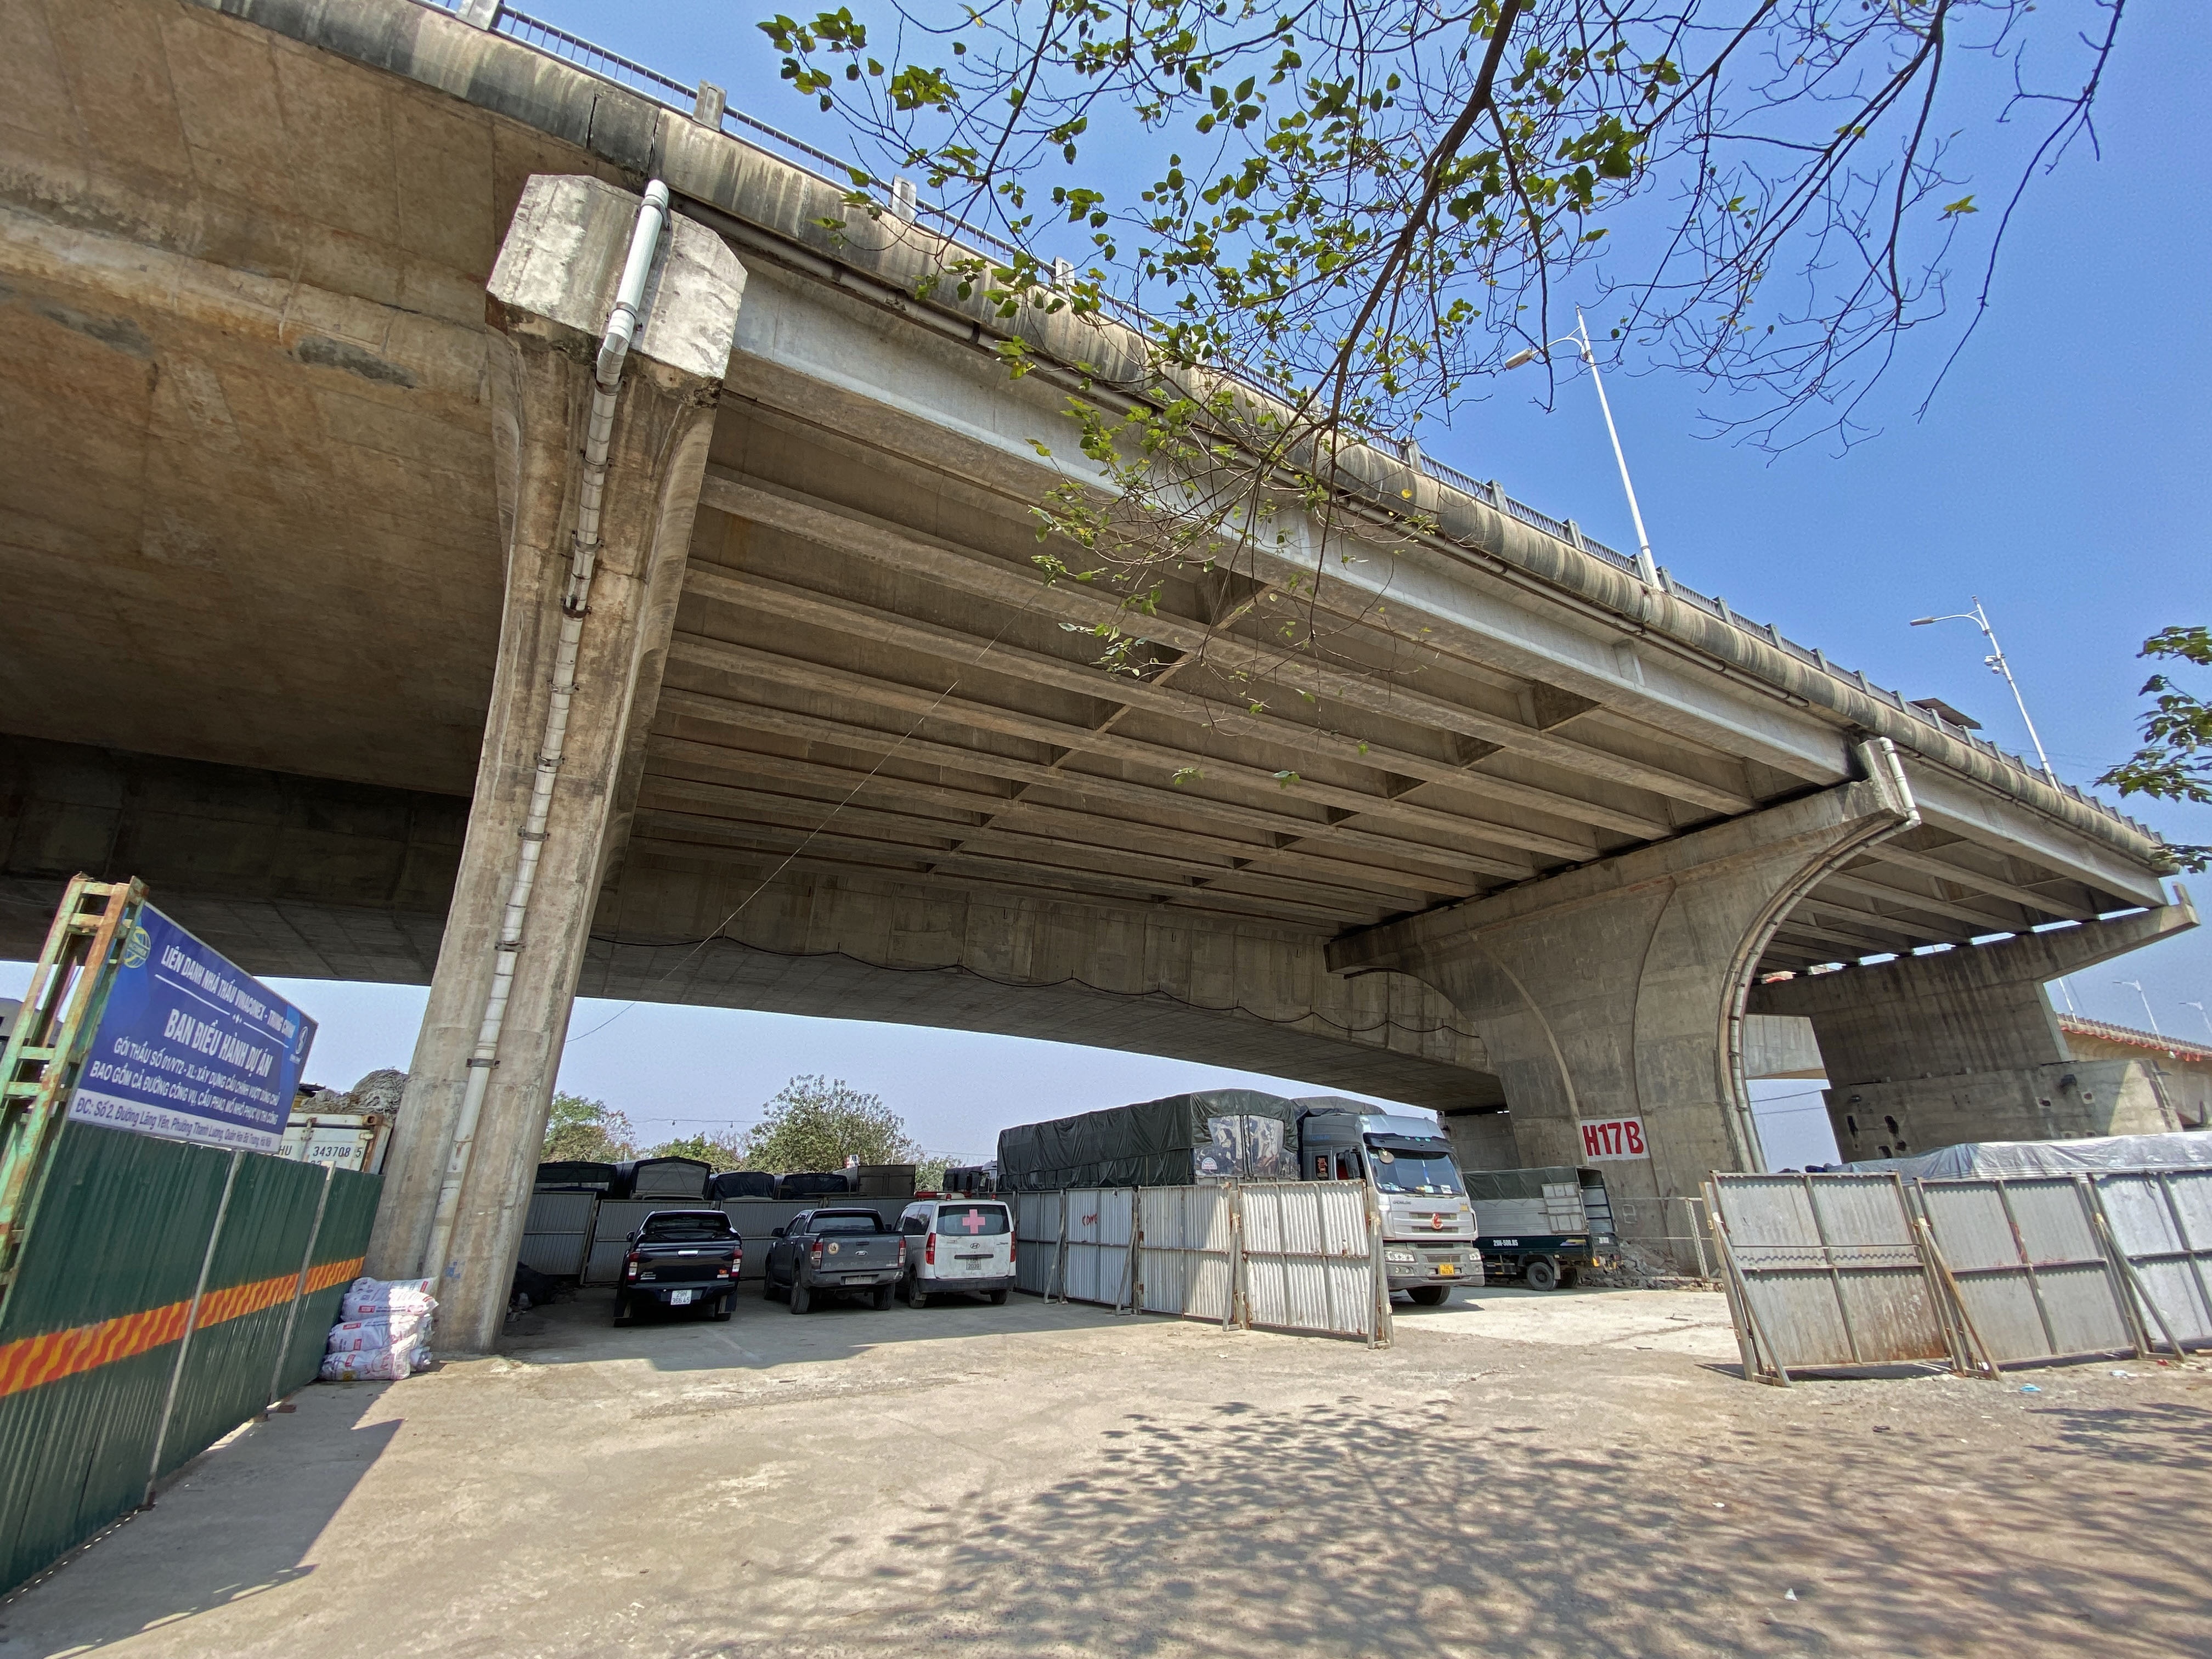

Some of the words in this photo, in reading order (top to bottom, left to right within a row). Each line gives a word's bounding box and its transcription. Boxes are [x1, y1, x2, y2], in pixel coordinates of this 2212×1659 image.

[161, 945, 185, 973] LIÊN
[180, 957, 205, 985] DANH
[201, 969, 221, 994] NHÀ
[217, 979, 238, 1003] THẦU
[234, 989, 266, 1021] VINACONEX
[114, 1036, 131, 1056] GÓI
[129, 1041, 152, 1063] THẦU
[150, 1047, 166, 1067] SỐ
[196, 1065, 211, 1083] XÂY
[208, 1072, 227, 1088] DỰNG
[163, 1008, 196, 1045] BAN
[191, 1019, 223, 1056] ĐIỀU
[218, 1032, 250, 1067] HÀNH
[245, 1046, 263, 1077] DỰ
[256, 1048, 273, 1077] ÁN
[89, 1060, 113, 1081] BAO
[112, 1063, 132, 1086] GỒM
[131, 1069, 145, 1090] CẢ
[142, 1075, 170, 1096] ĐƯỜNG
[169, 1082, 189, 1101] CÔNG
[198, 1088, 213, 1107] CẦU
[76, 1098, 93, 1114] ĐC:
[94, 1101, 110, 1116] Số
[115, 1105, 139, 1127] Đường
[313, 1146, 351, 1156] 343708
[356, 1147, 364, 1158] 5
[1582, 1121, 1644, 1156] H17B
